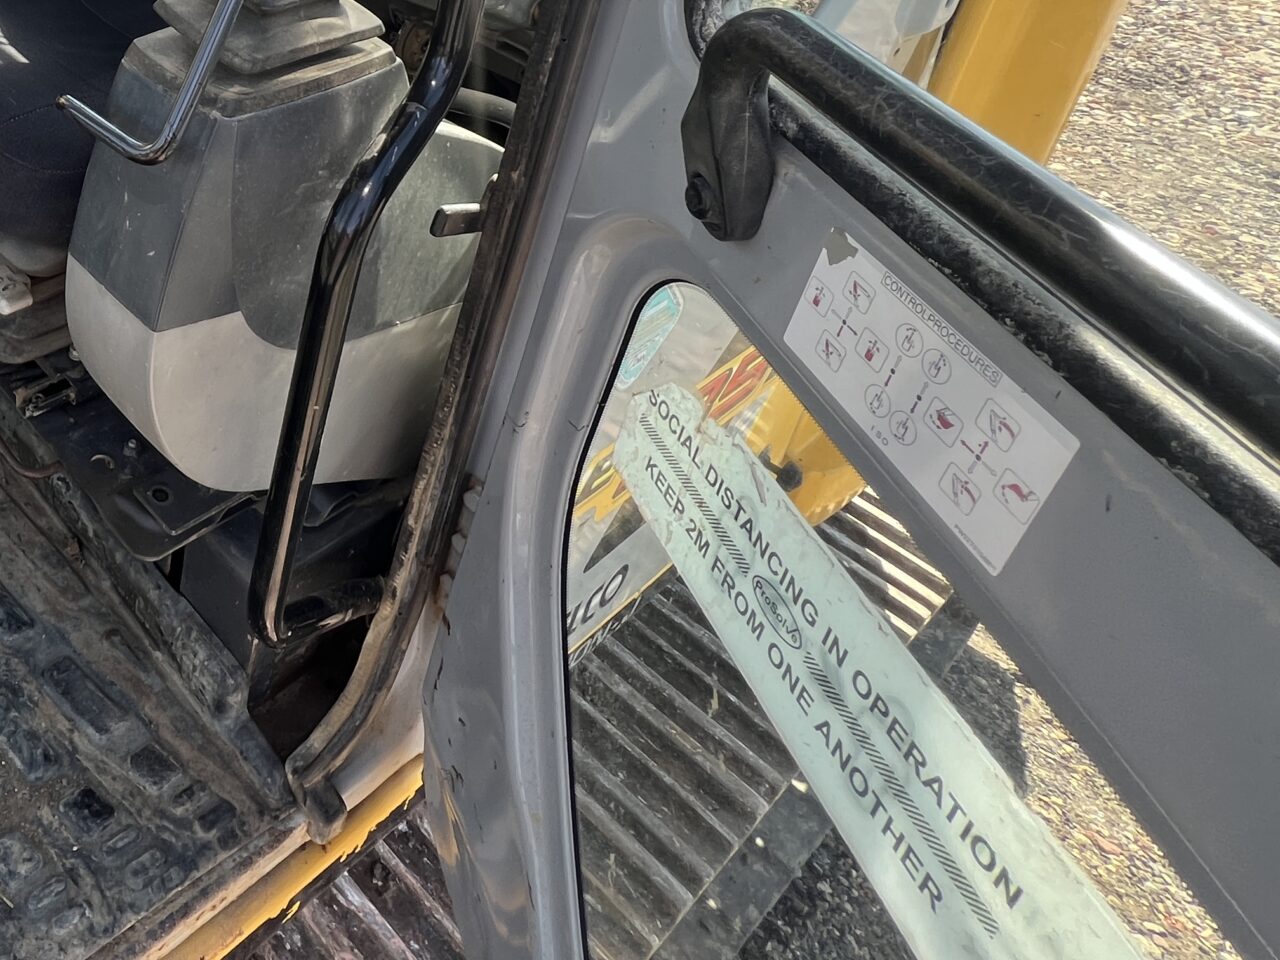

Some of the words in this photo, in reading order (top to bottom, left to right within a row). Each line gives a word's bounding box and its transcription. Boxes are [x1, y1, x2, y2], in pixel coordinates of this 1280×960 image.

[567, 563, 629, 635] LCO
[645, 456, 685, 517] KEEP
[685, 518, 710, 559] 2M
[711, 555, 765, 642] FROM
[768, 642, 815, 718] ONE
[813, 720, 944, 914] ANOTHER
[648, 390, 702, 470] SOCIAL
[705, 464, 819, 628] DISTANCING
[822, 626, 849, 669] IN
[852, 670, 1024, 910] OPERATION
